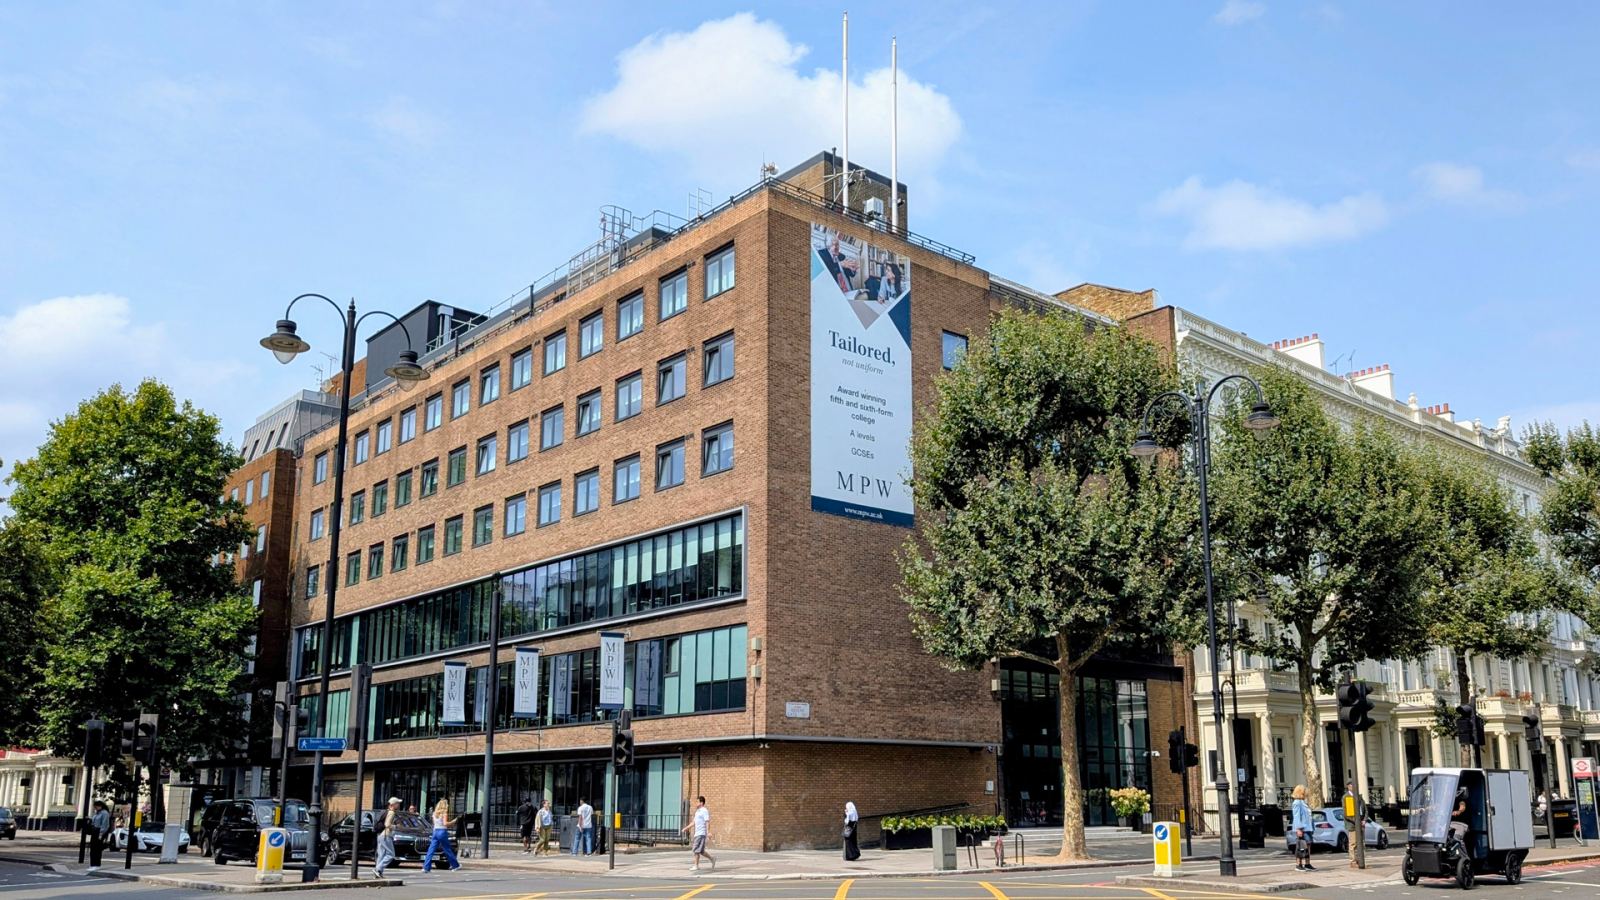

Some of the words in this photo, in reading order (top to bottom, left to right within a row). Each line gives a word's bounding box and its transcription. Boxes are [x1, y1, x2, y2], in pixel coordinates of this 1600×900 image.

[828, 329, 896, 368] Tailored,
[841, 358, 855, 368] not
[855, 361, 885, 375] uniform
[837, 385, 860, 398] Award
[860, 390, 887, 407] winning
[829, 394, 844, 405] fifth
[845, 400, 859, 409] and
[859, 403, 894, 418] sixth-form
[850, 413, 876, 425] college
[849, 429, 856, 438] A
[856, 431, 876, 442] levels
[850, 447, 875, 460] GCSEs
